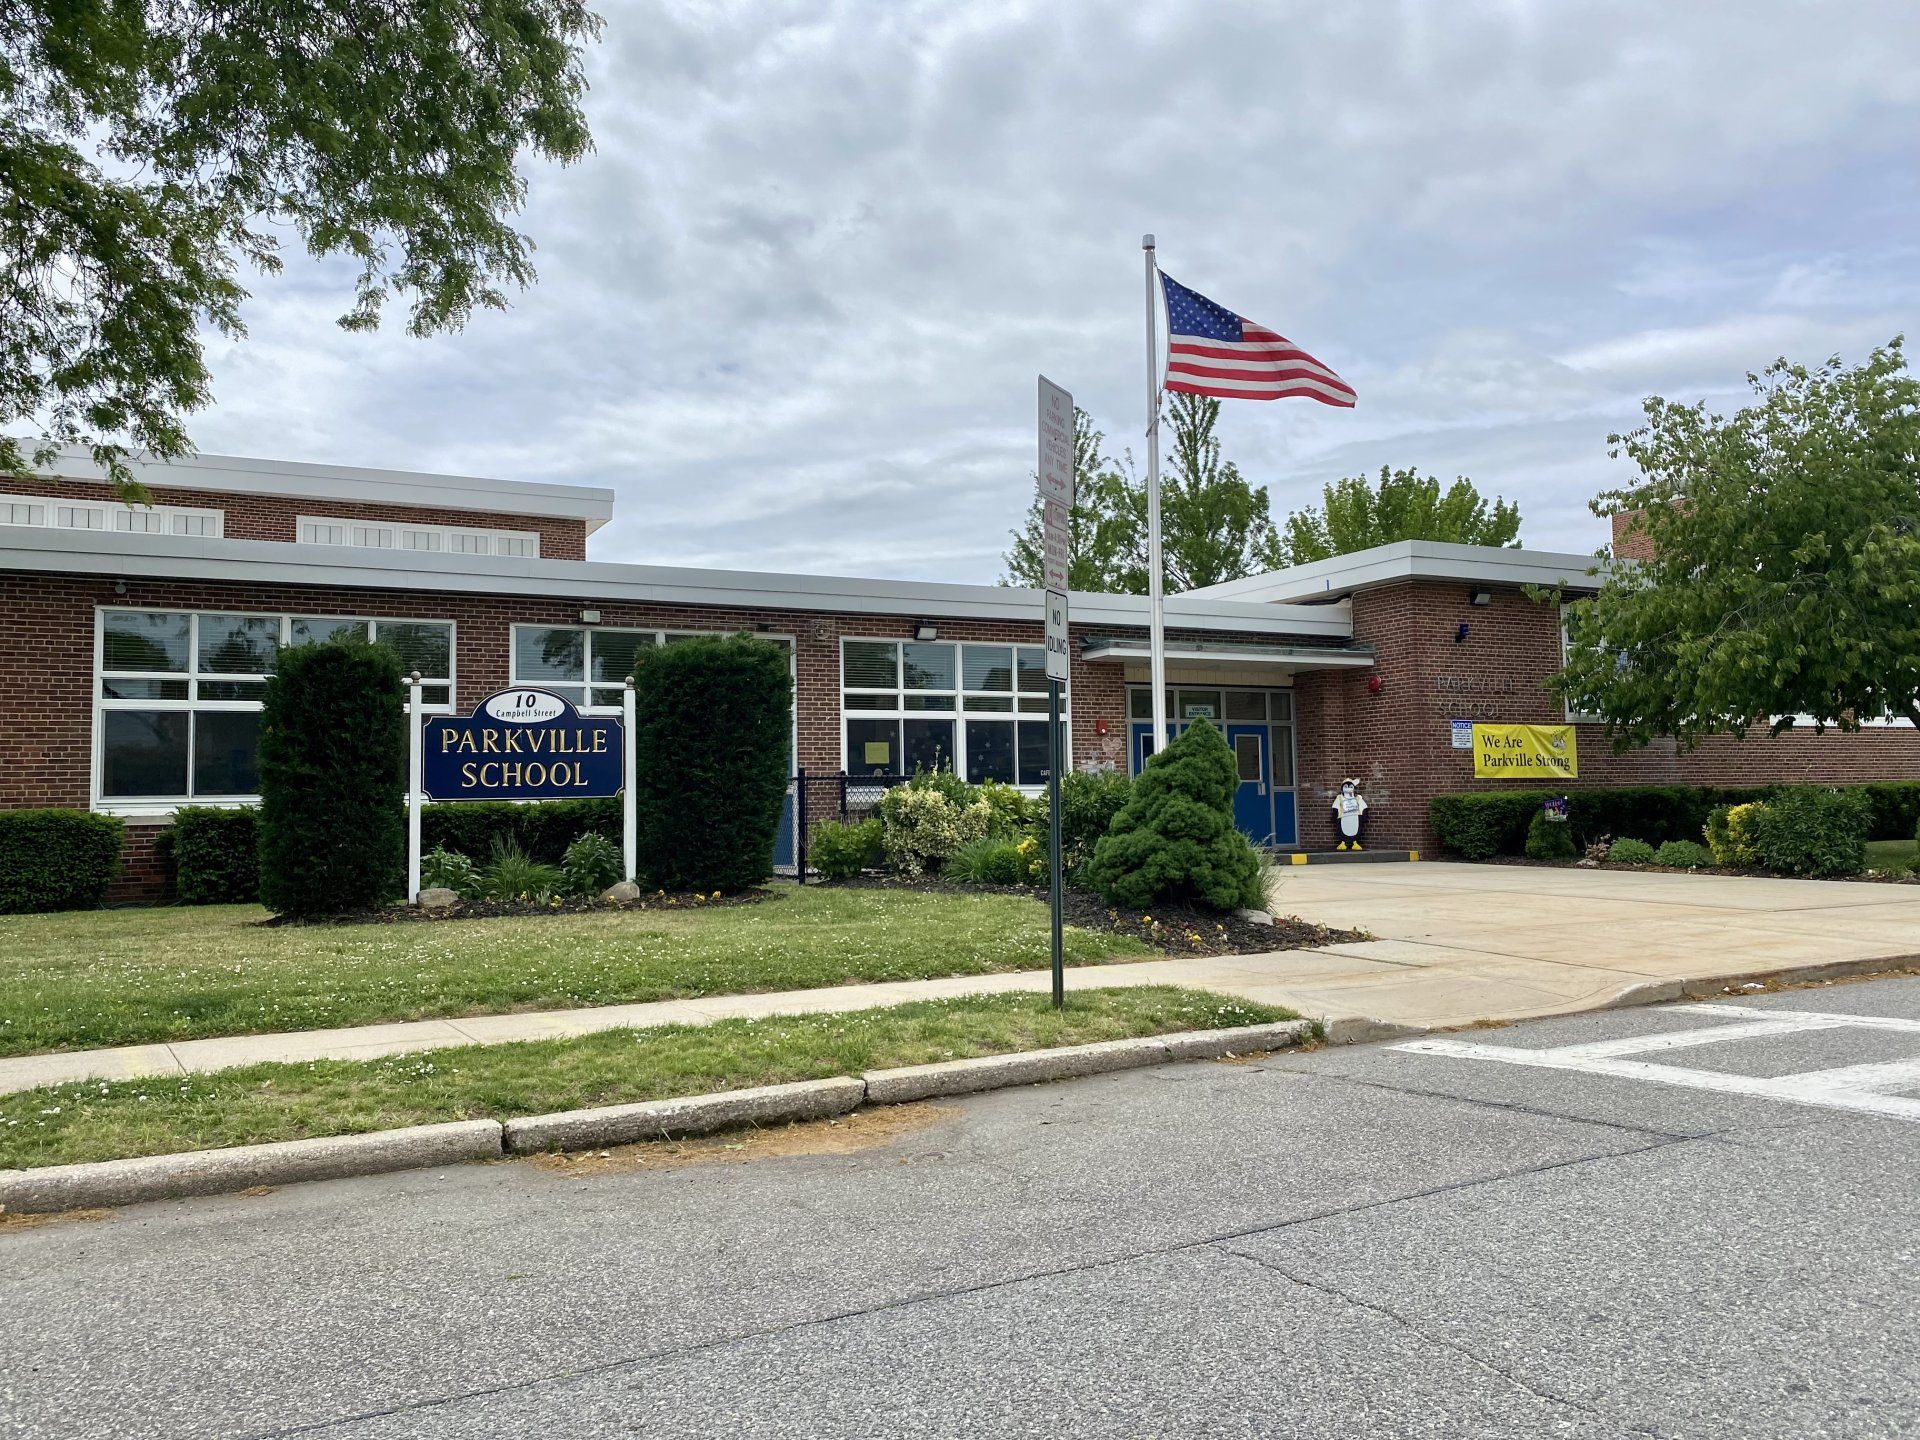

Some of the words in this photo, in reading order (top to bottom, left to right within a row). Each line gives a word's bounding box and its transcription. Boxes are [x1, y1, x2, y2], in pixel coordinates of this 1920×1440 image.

[1052, 609, 1061, 626] NO
[1047, 635, 1067, 655] IDLING
[516, 694, 537, 708] 10
[496, 709, 531, 719] Campbell
[534, 708, 556, 717] Street
[441, 728, 607, 753] PARKVILLE
[1482, 735, 1500, 748] We
[1504, 735, 1523, 748] Are
[1483, 753, 1533, 767] Parkville
[1535, 753, 1571, 771] Strong
[461, 762, 589, 788] SCHOOL
